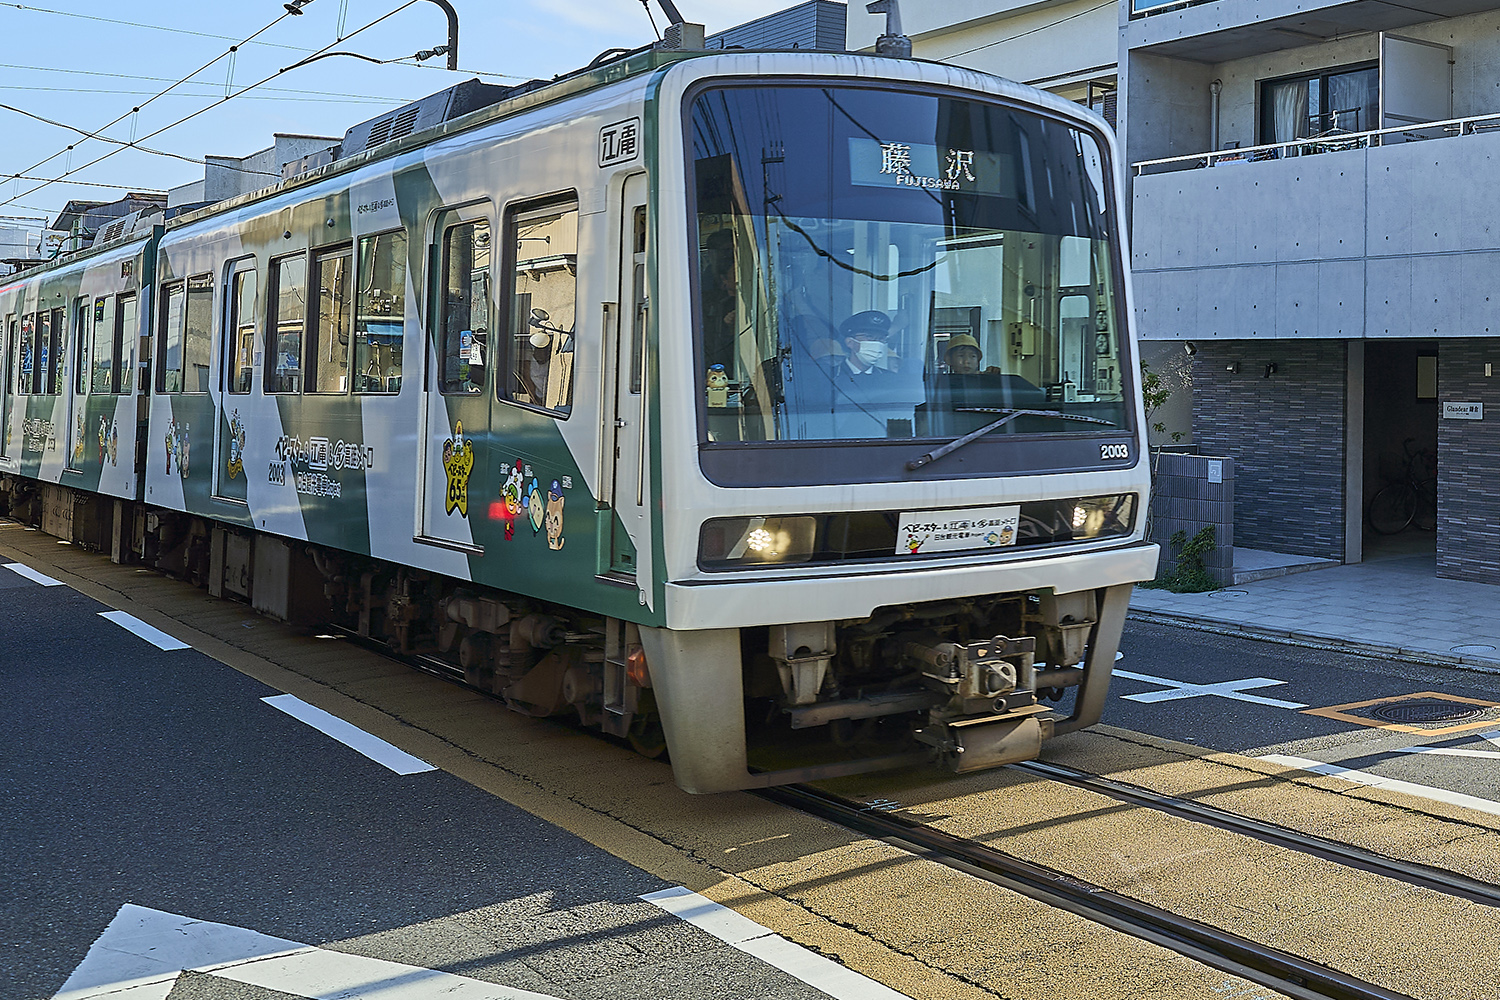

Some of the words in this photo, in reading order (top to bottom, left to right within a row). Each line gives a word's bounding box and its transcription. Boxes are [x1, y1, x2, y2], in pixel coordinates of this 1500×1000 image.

[879, 142, 976, 182] 藤沢
[896, 174, 961, 190] FUJISAWA
[1101, 444, 1129, 459] 2003
[901, 522, 942, 533] ベビースター
